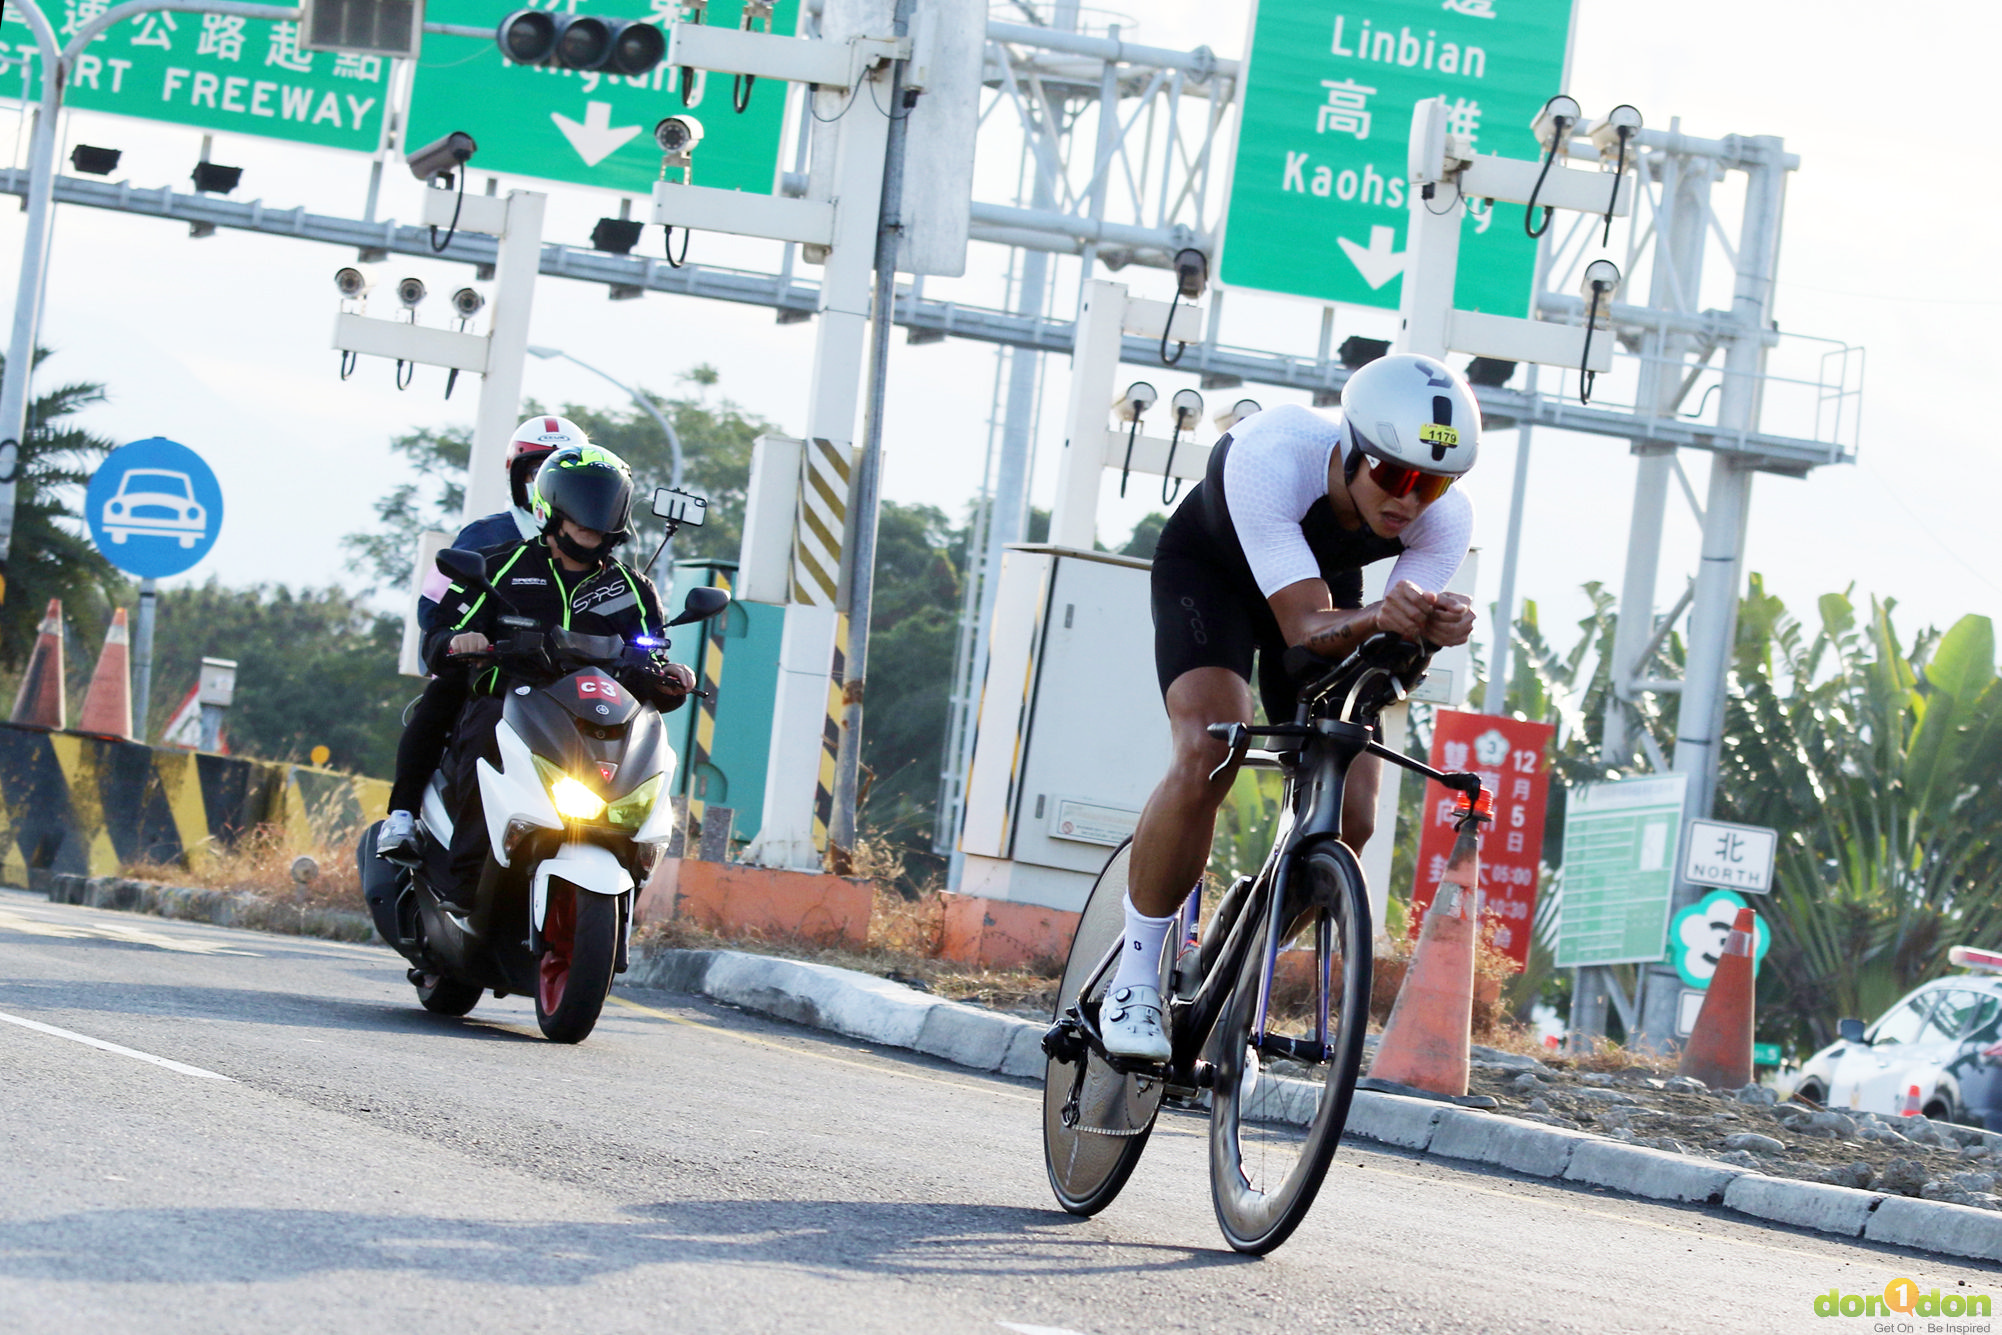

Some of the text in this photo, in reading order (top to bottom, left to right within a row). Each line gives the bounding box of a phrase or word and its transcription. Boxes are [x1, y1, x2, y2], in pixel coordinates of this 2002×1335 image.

[1331, 15, 1486, 78] Linbian
[0, 40, 376, 131] TRT FREEWAY
[1283, 150, 1494, 234] Kaohsg
[1429, 430, 1457, 444] 1179
[1715, 832, 1745, 863] 北
[1693, 864, 1761, 884] NORTH
